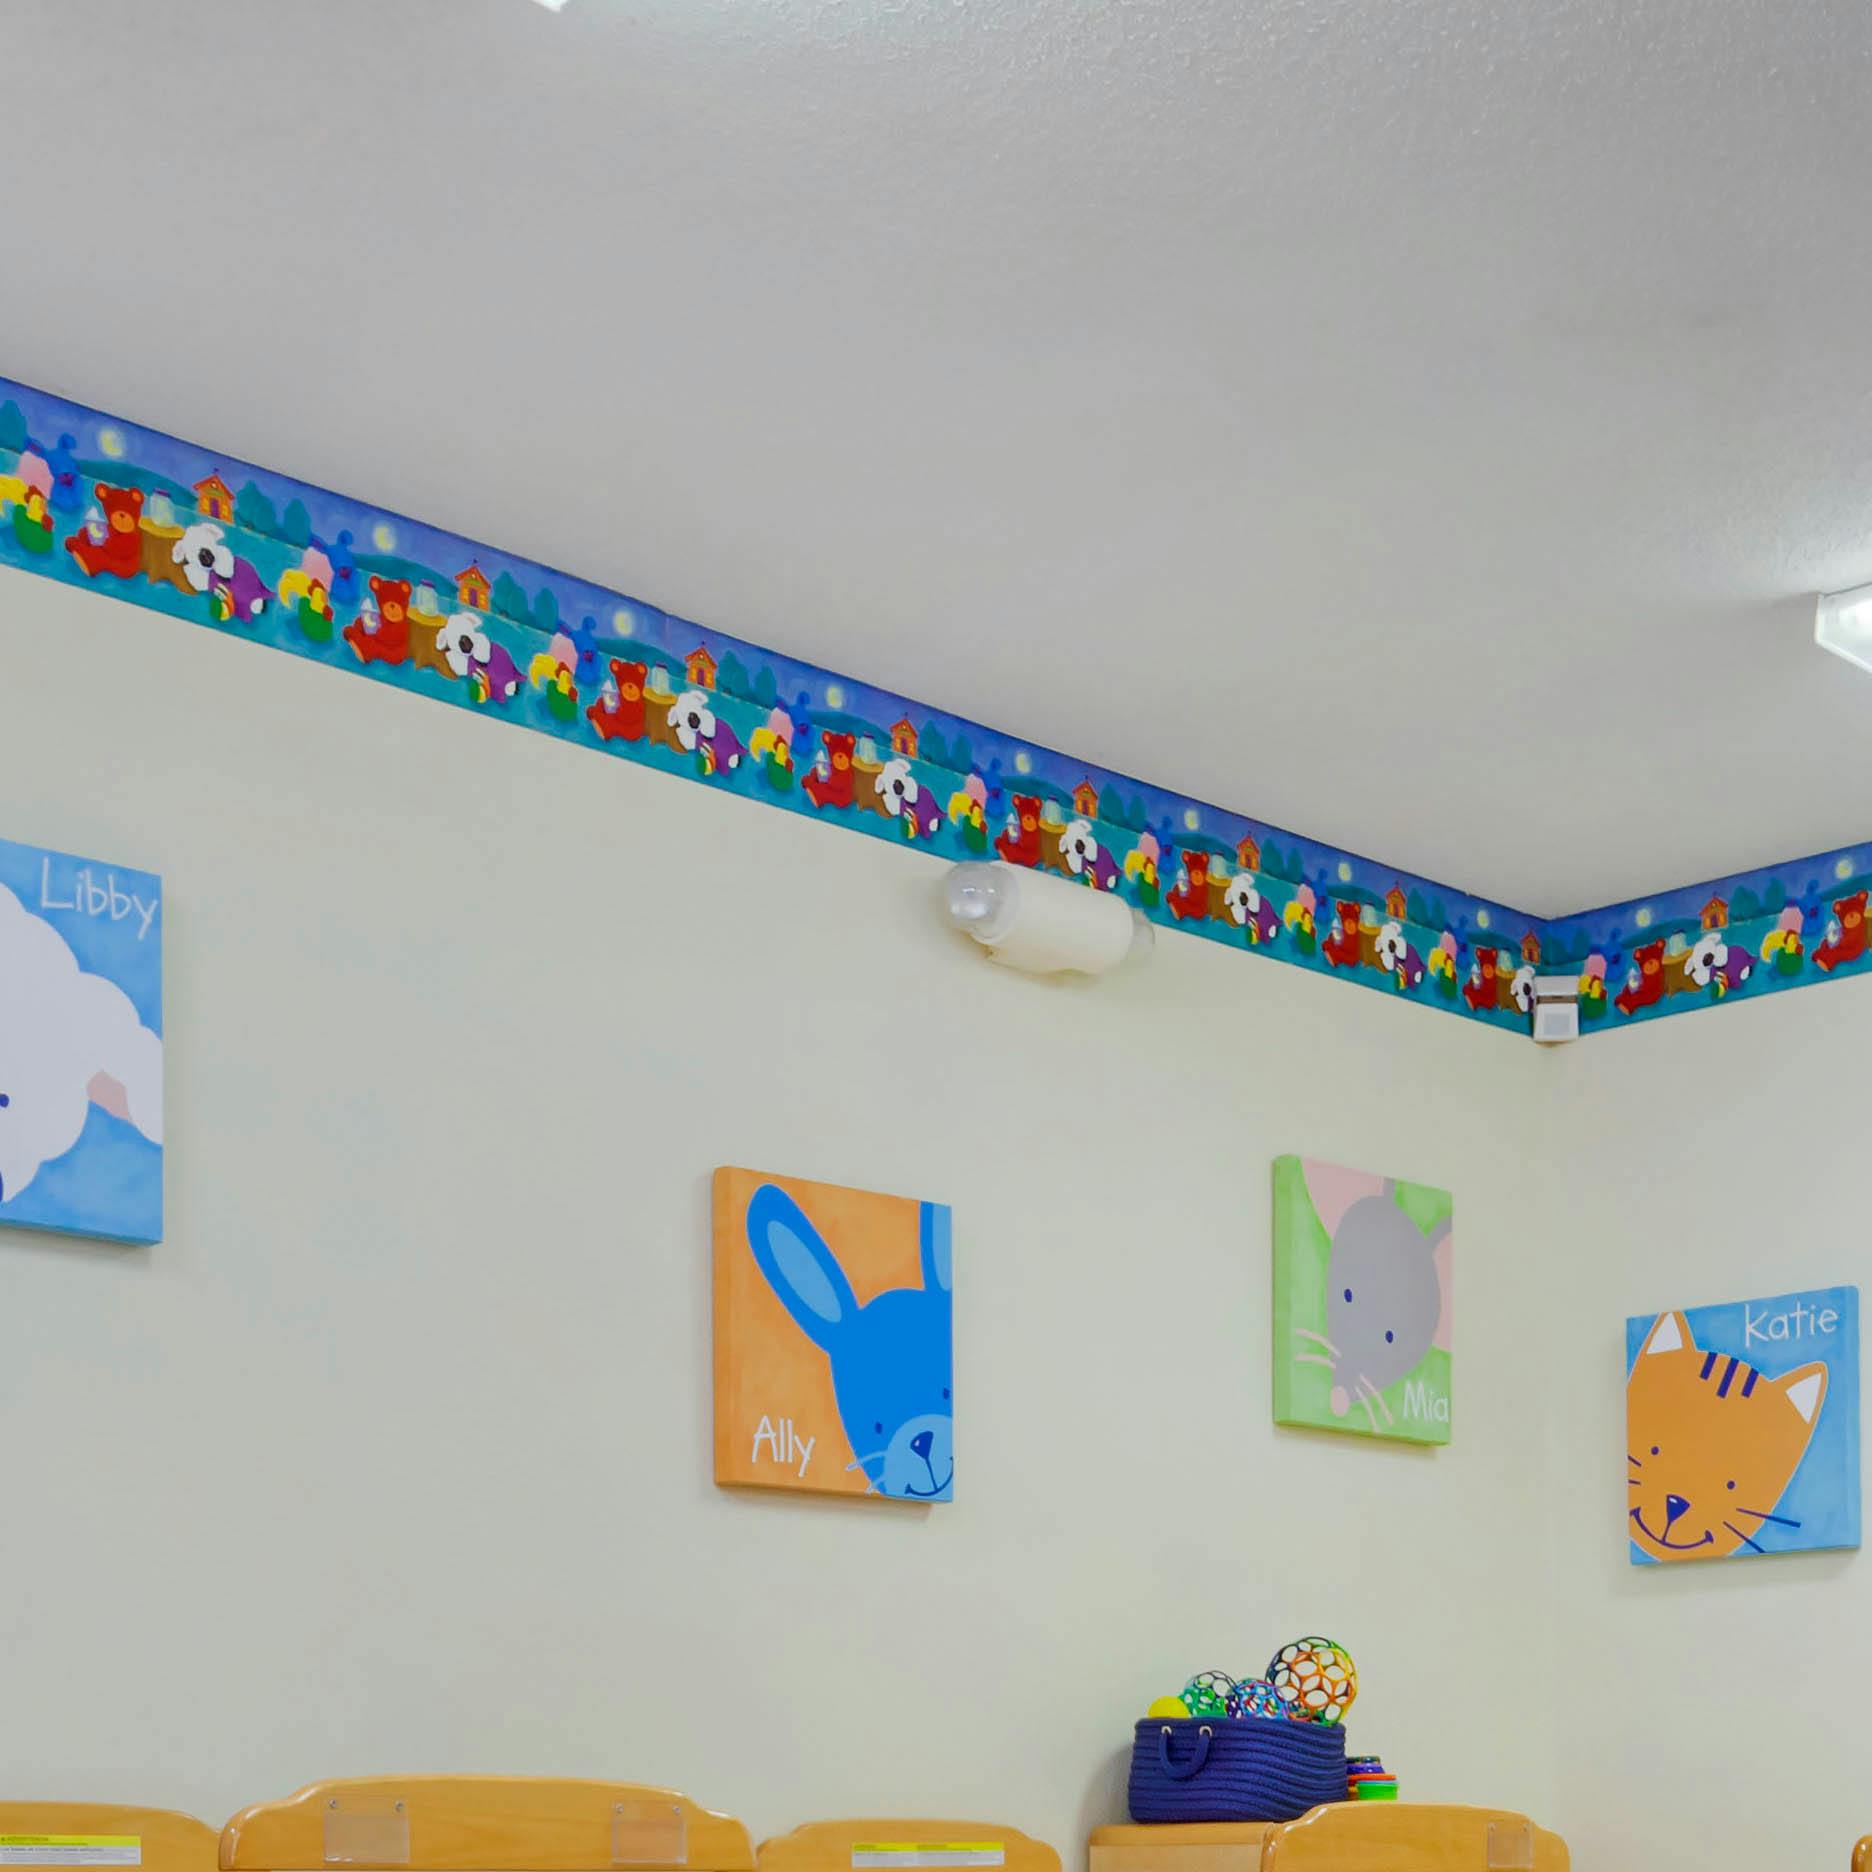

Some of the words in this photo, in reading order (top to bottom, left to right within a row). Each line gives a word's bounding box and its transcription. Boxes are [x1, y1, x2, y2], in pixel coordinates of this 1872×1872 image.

[40, 856, 158, 940] Libby
[1744, 1300, 1839, 1348] Katie
[1402, 1380, 1449, 1423] Mia
[751, 1415, 816, 1478] Ally
